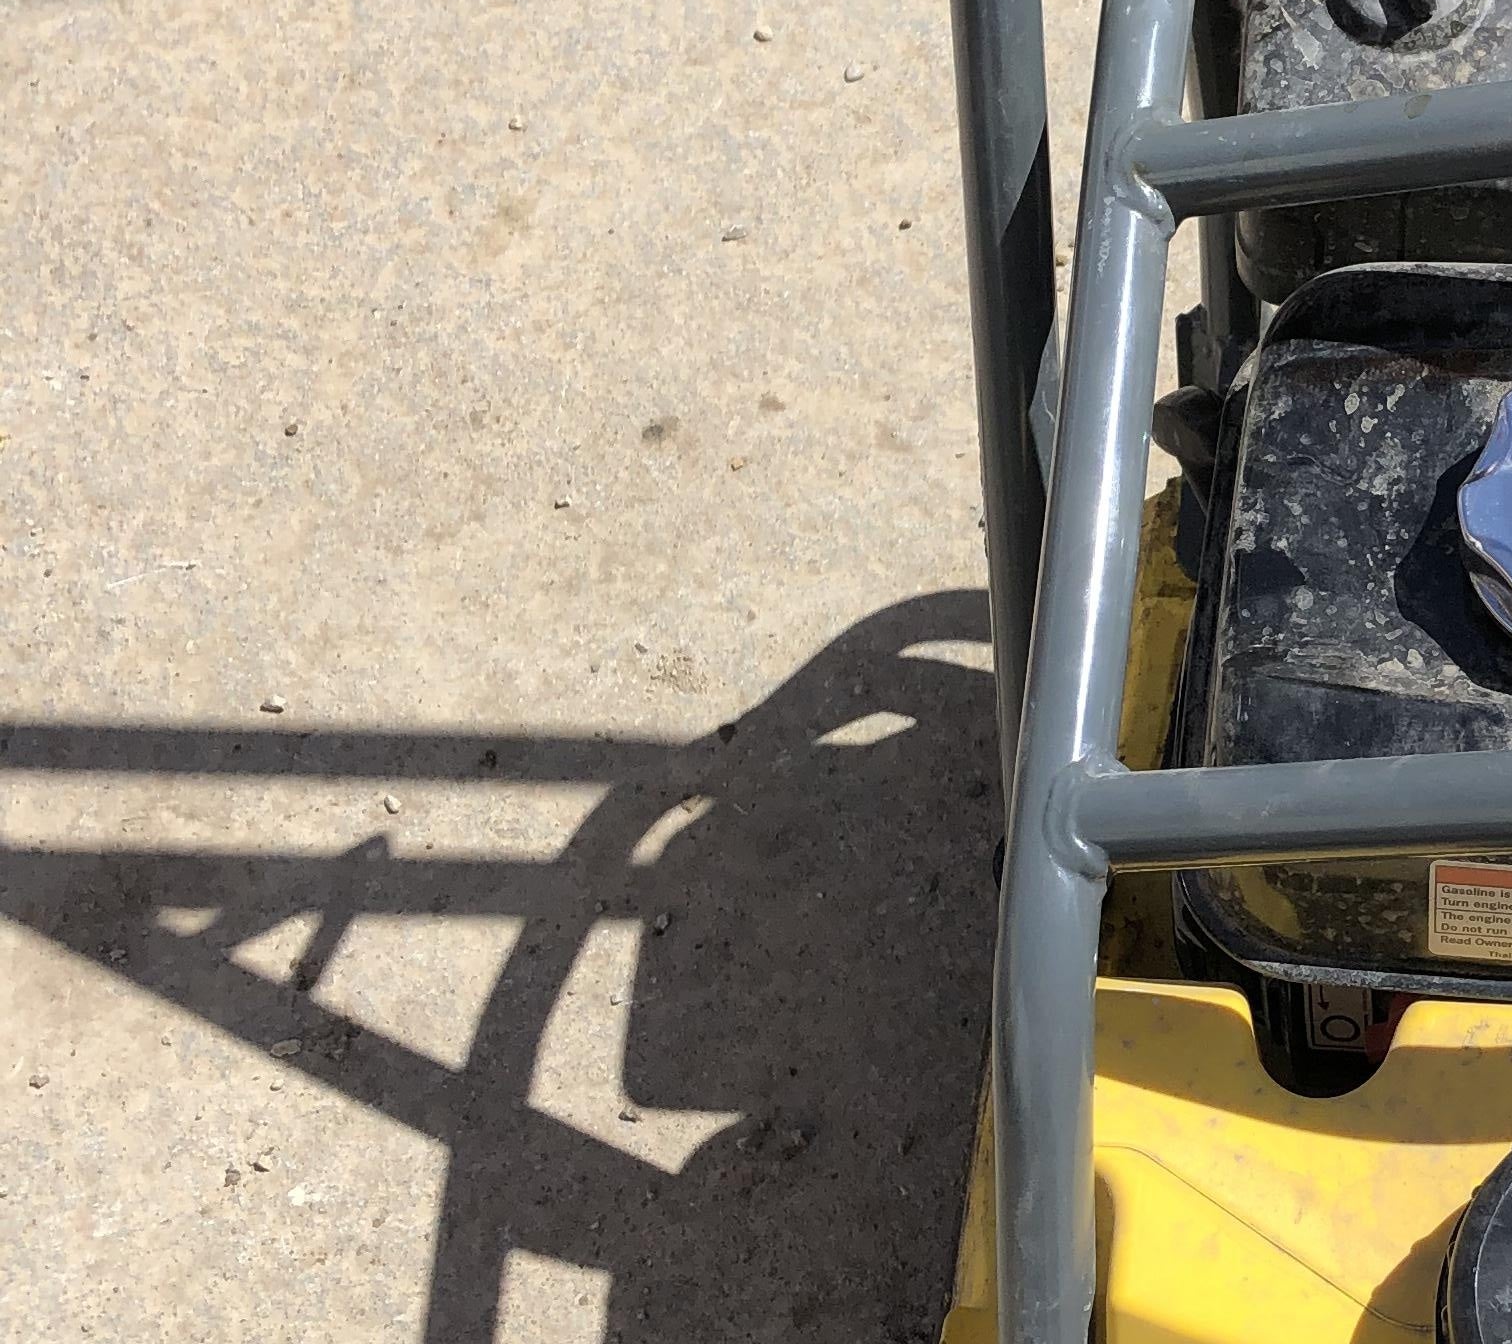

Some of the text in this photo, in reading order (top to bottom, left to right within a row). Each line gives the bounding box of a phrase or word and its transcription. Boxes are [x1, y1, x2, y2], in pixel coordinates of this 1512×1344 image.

[1442, 885, 1496, 898] Gasoline
[1500, 888, 1510, 898] is
[1441, 897, 1469, 907] Turn
[1441, 912, 1464, 921] The
[1468, 916, 1511, 926] engine
[1440, 923, 1458, 932] Do
[1462, 926, 1482, 934] not
[1486, 927, 1508, 936] run
[1440, 936, 1471, 946] Read
[1489, 950, 1512, 959] Thai
